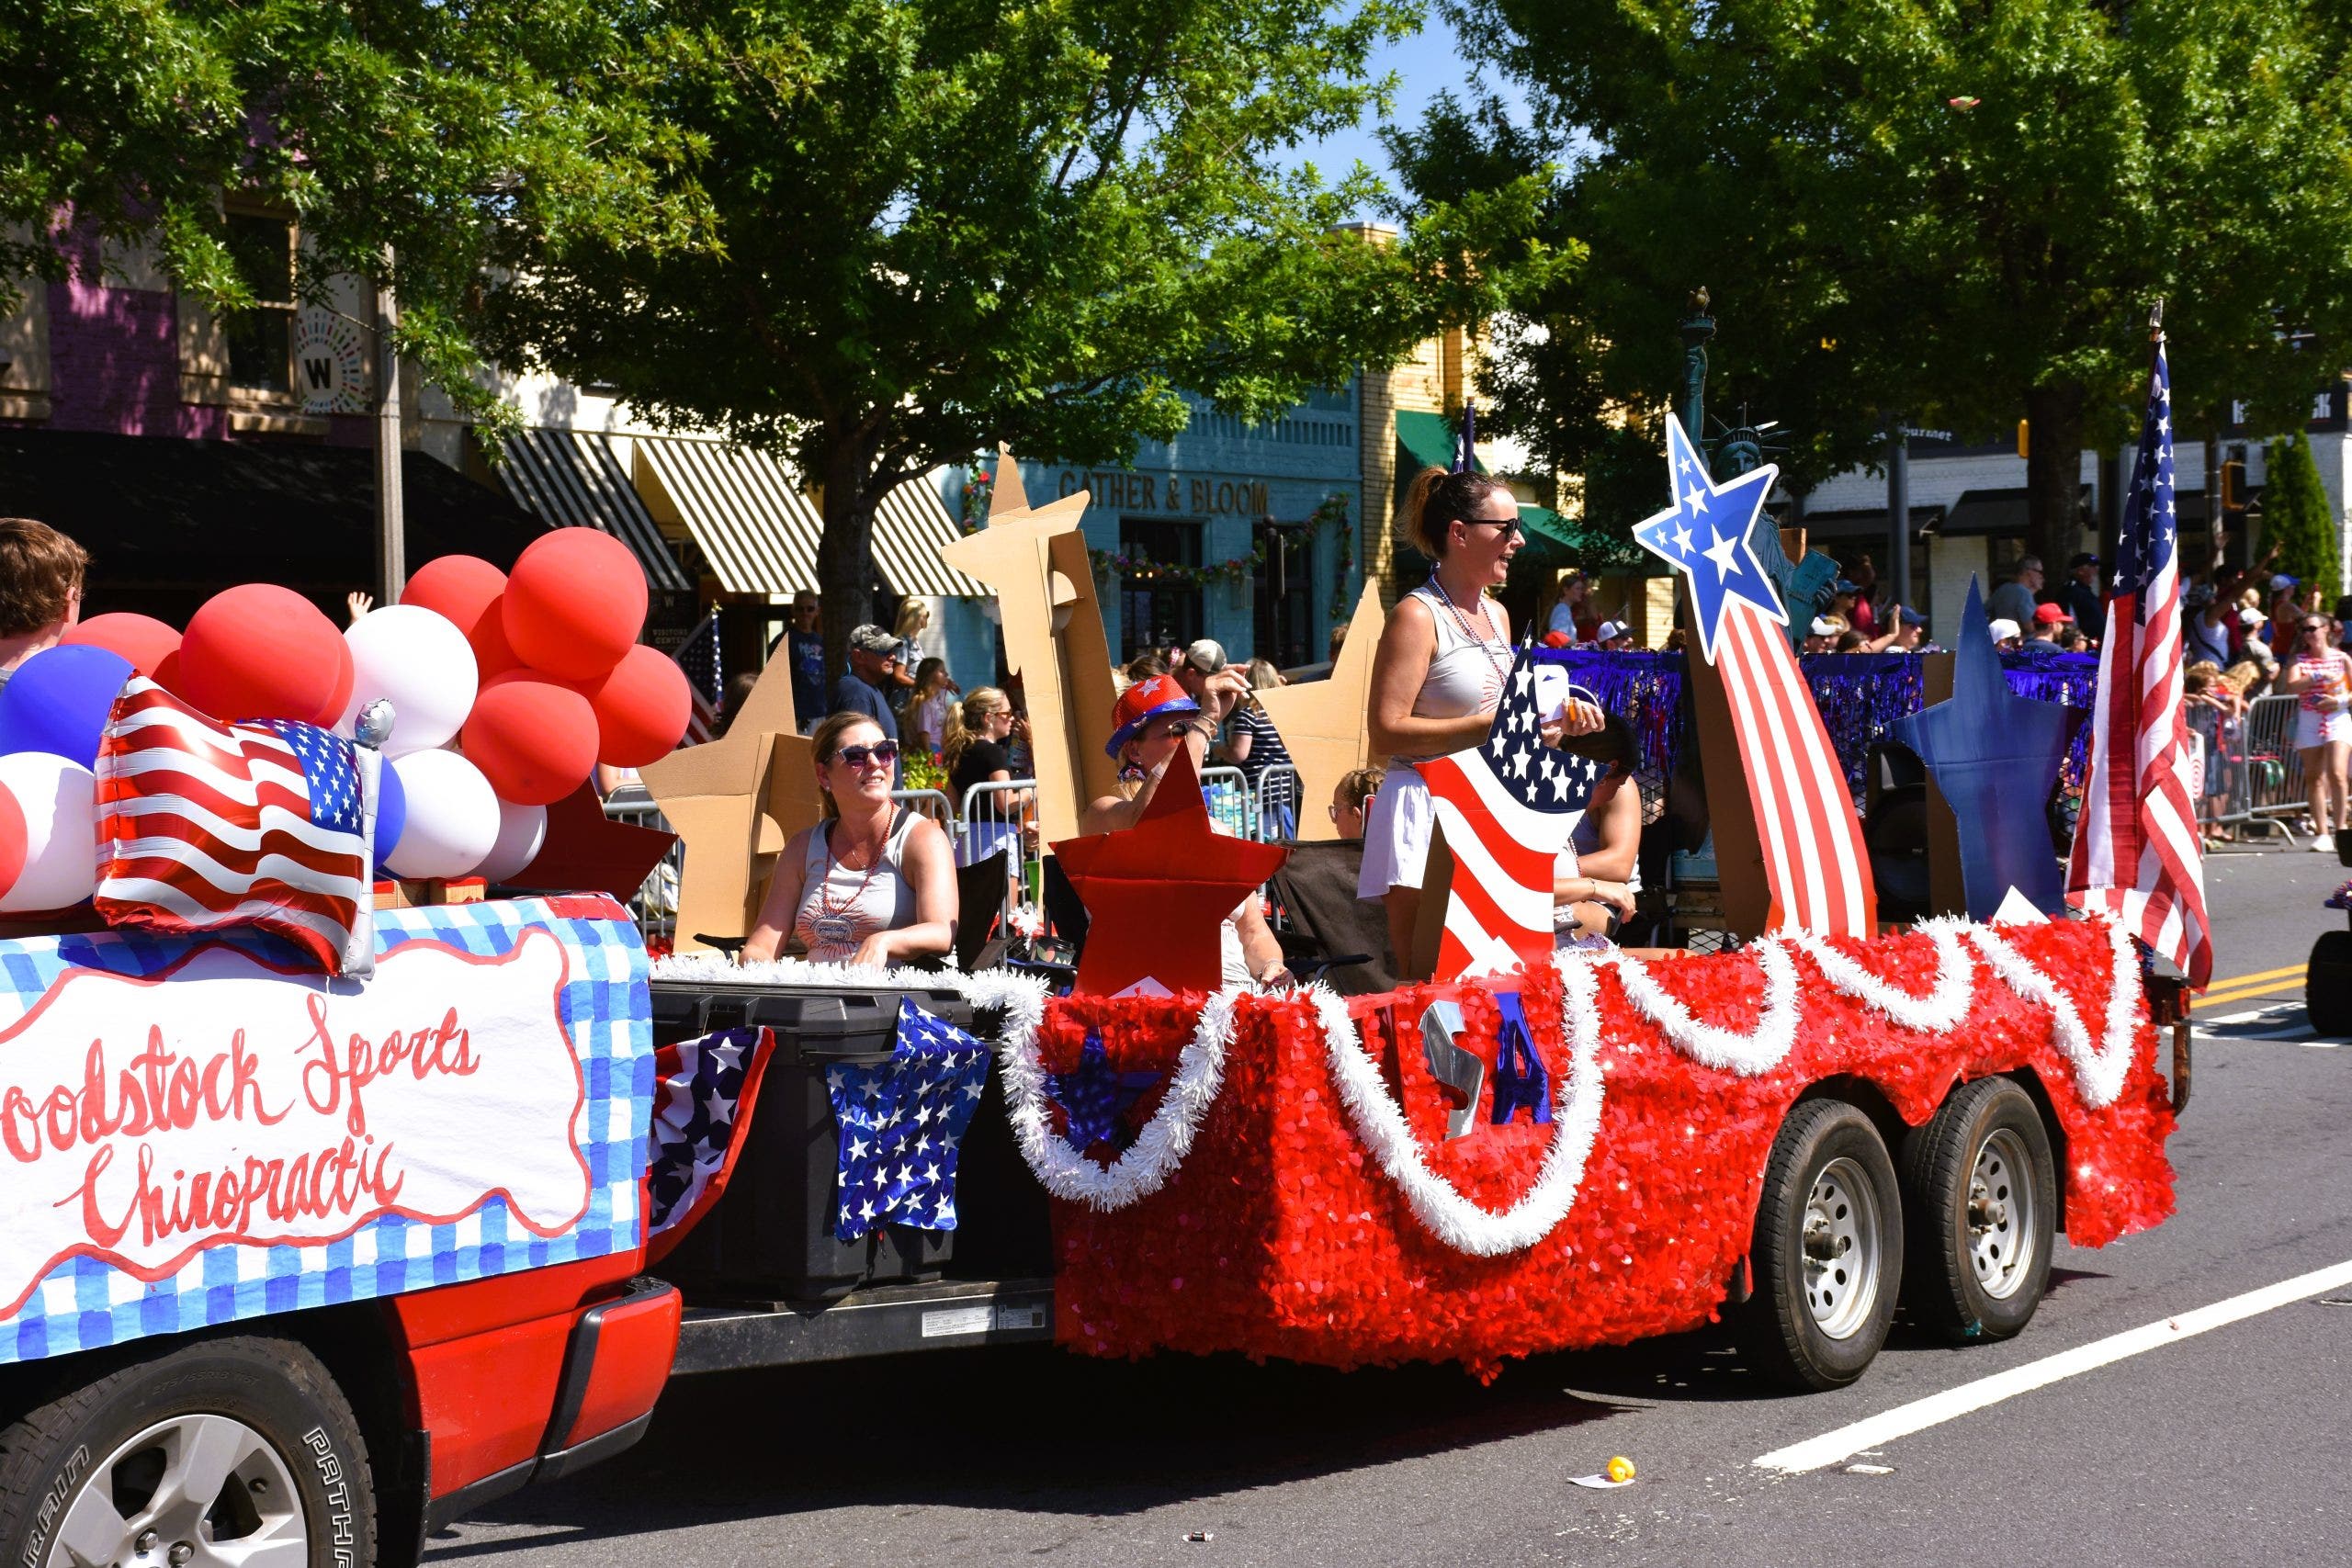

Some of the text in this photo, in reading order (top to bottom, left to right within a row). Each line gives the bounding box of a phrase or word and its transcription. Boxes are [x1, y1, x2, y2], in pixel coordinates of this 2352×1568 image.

[303, 357, 332, 390] W
[1058, 469, 1269, 515] GATHER & BLOOM
[0, 992, 481, 1163] oodstock Sports
[52, 1134, 404, 1249] Chiropractic
